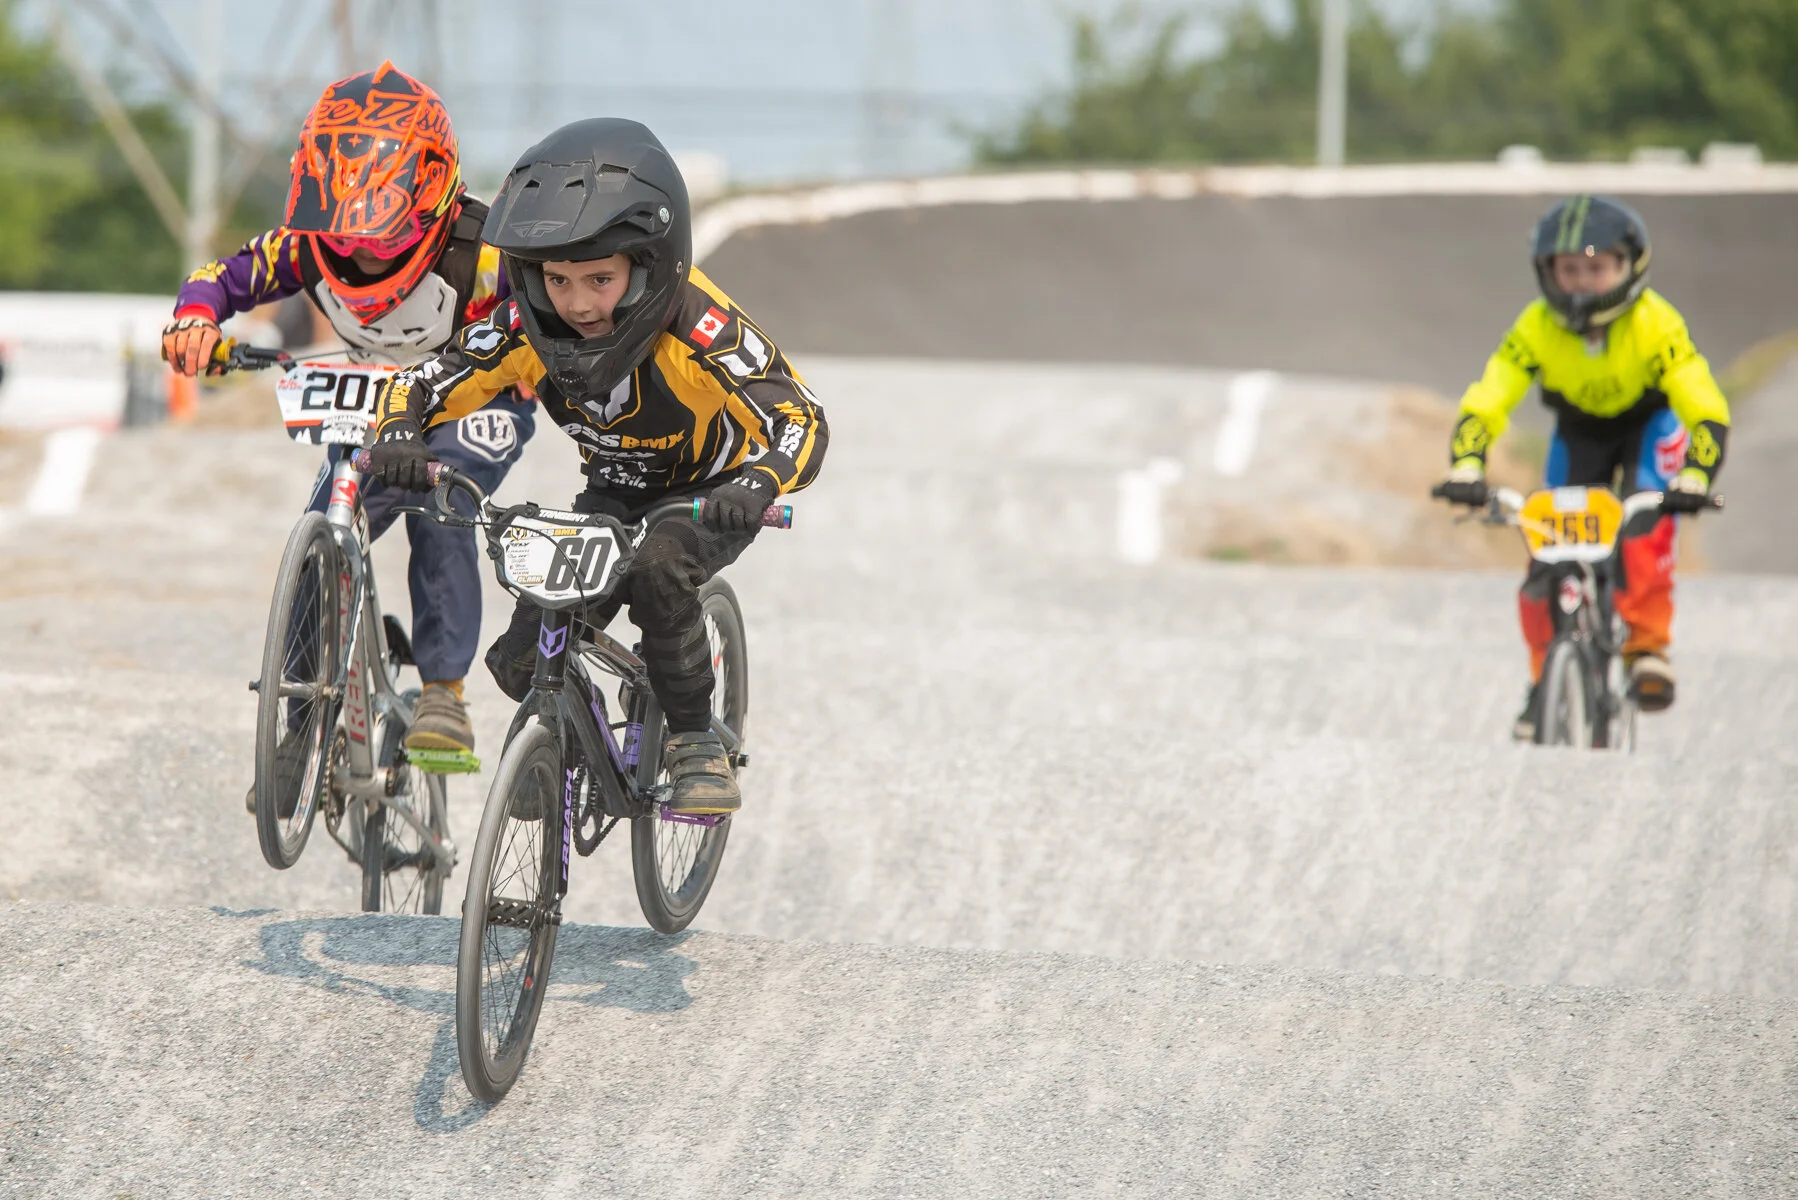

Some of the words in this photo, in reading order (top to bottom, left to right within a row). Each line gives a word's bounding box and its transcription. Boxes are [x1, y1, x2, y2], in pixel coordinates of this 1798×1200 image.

[301, 371, 387, 414] 201
[384, 430, 414, 442] FLY
[732, 477, 762, 489] FLY
[539, 509, 590, 523] TANGENT
[545, 537, 613, 591] 60
[562, 768, 573, 866] REACH
